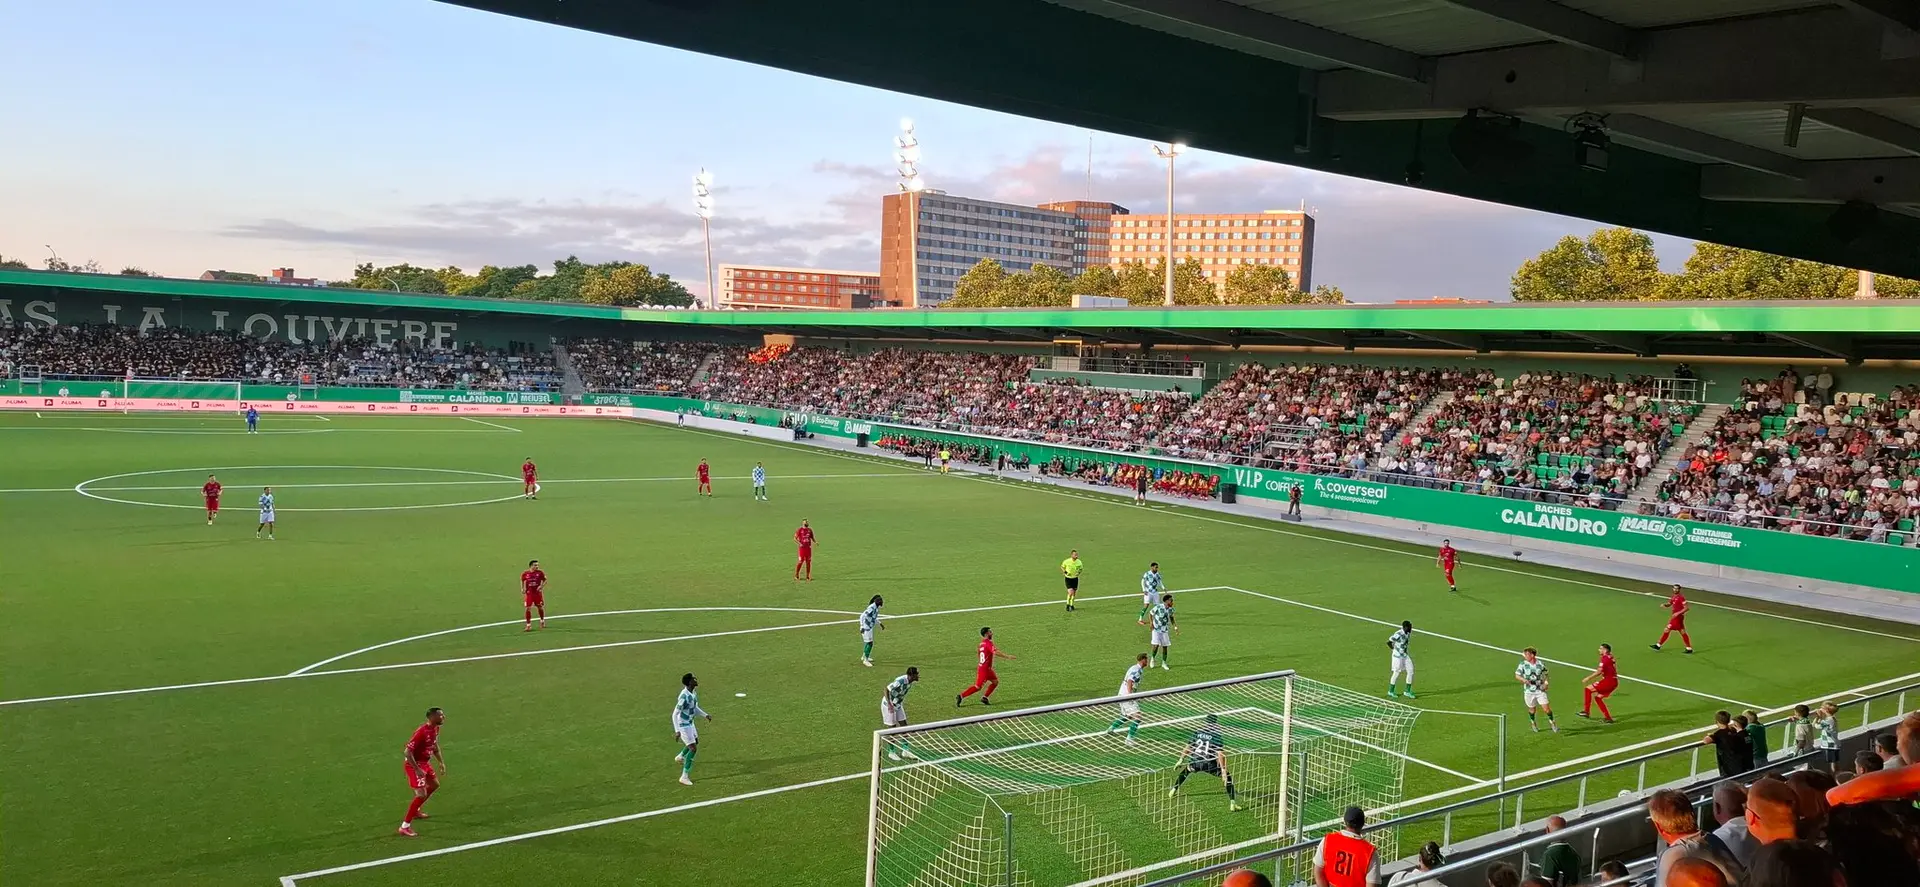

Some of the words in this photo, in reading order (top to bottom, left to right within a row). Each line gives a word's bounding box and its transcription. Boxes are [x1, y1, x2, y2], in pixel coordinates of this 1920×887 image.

[449, 395, 503, 403] CALANDRO
[1265, 480, 1304, 495] COIFFUE
[1327, 482, 1387, 499] coverseal
[1320, 491, 1331, 499] The
[1535, 504, 1572, 516] BACHES
[1501, 508, 1607, 536] CALANDRO
[1686, 534, 1742, 548] TERRASSEMENT
[1692, 528, 1732, 540] CONTAINER
[1195, 739, 1209, 755] 21
[417, 777, 426, 787] 25
[1335, 850, 1353, 876] 21
